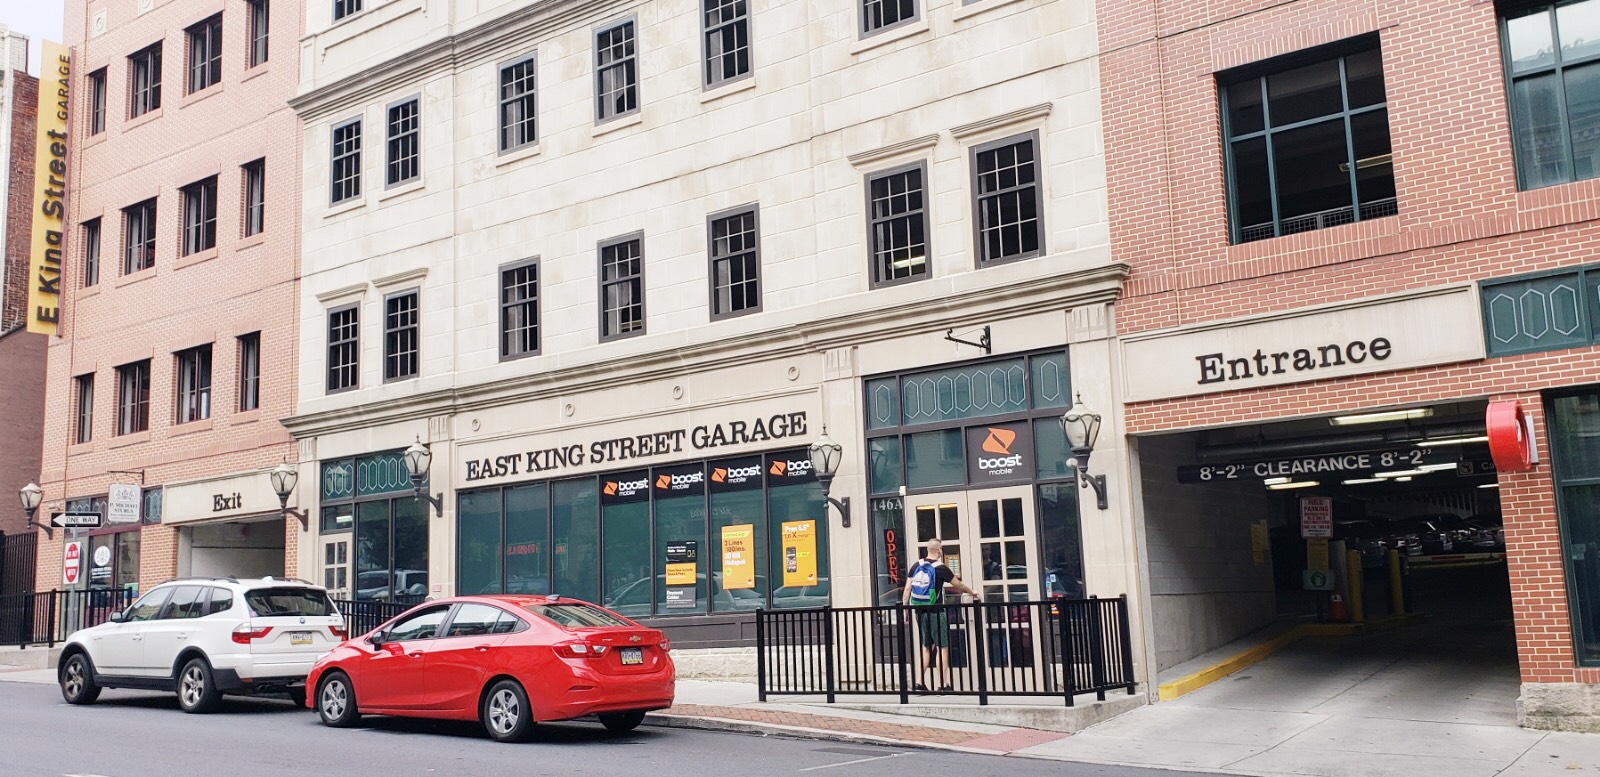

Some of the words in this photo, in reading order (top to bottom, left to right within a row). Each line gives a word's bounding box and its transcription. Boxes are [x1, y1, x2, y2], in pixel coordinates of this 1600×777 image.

[57, 54, 71, 122] GARAGE
[42, 128, 68, 219] Street
[38, 229, 63, 294] King
[37, 305, 59, 324] E
[1195, 337, 1391, 384] Entrance
[466, 453, 521, 481] EAST
[526, 444, 585, 473] KING
[590, 429, 686, 463] STREET
[691, 411, 807, 449] GARAGE
[728, 464, 761, 478] boost
[979, 453, 1023, 470] boost
[1254, 454, 1371, 476] CLEARANCE
[672, 471, 704, 485] boost
[989, 468, 1013, 476] mobile
[618, 478, 649, 491] boost
[672, 484, 690, 492] mobile
[212, 492, 242, 512] Exit
[873, 498, 903, 512] 146A
[785, 525, 797, 533] Free
[886, 530, 898, 584] OPEN
